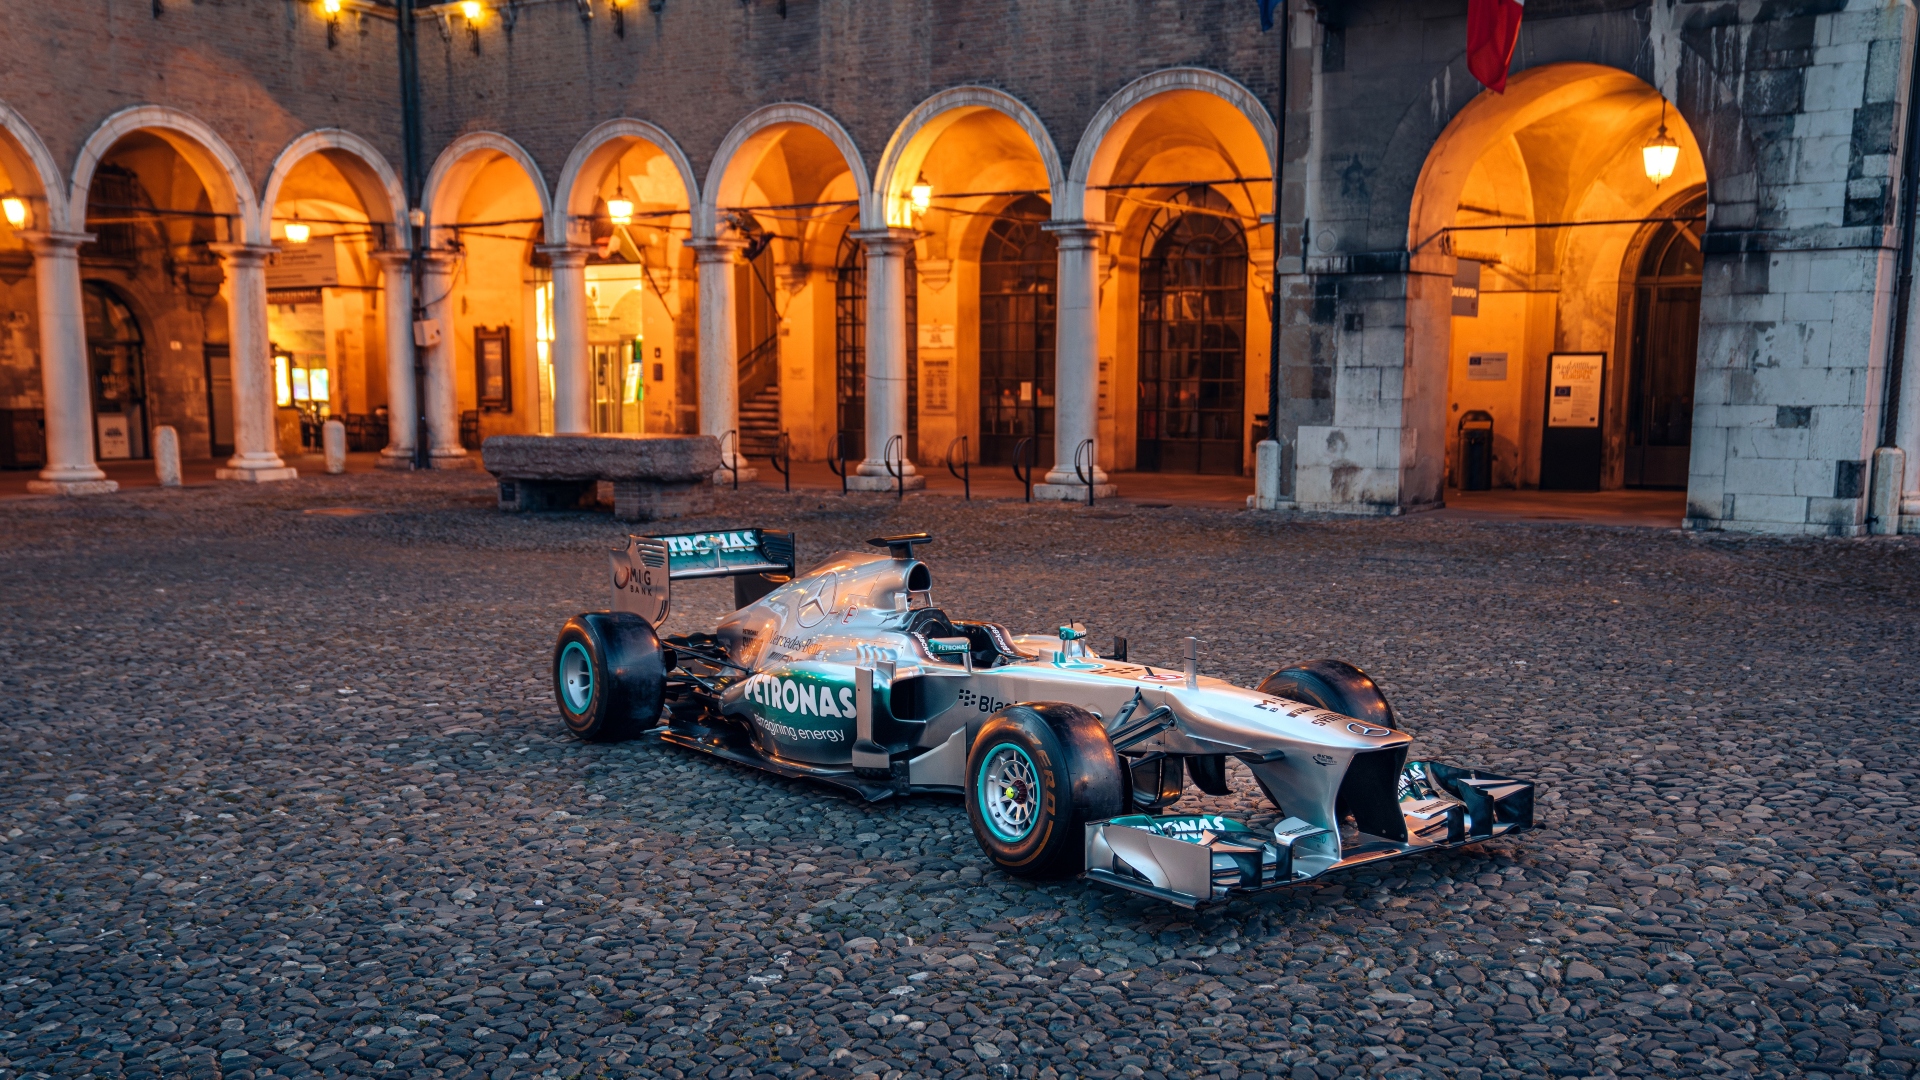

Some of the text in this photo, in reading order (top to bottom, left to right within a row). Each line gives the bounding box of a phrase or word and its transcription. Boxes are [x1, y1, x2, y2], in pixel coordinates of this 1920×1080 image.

[630, 586, 652, 597] BANK
[744, 673, 857, 719] PETRONAS
[798, 729, 845, 743] energy
